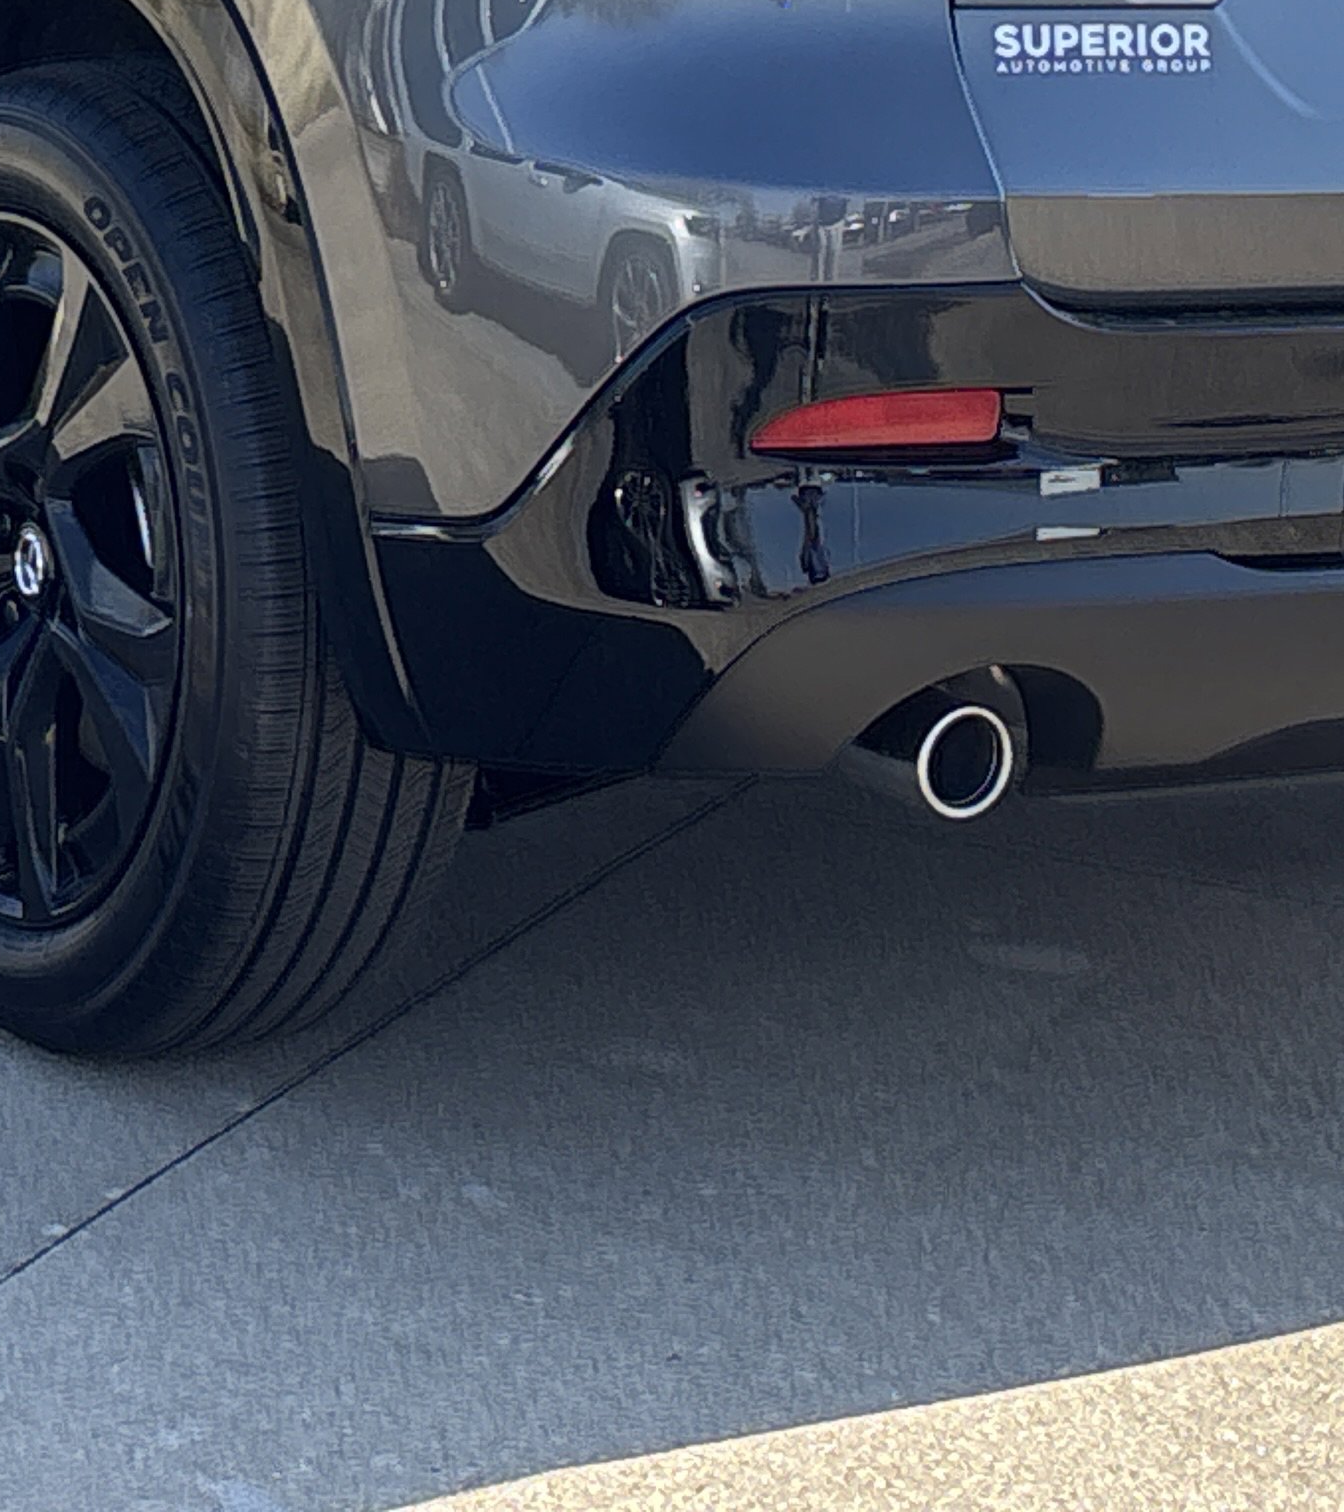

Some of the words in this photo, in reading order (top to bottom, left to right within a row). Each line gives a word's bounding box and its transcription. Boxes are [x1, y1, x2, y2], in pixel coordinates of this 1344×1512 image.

[993, 22, 1212, 58] SUPERIOR
[995, 59, 1131, 74] AUTOMOTIVE
[1142, 58, 1213, 74] GROUP
[82, 194, 171, 344] OPEN
